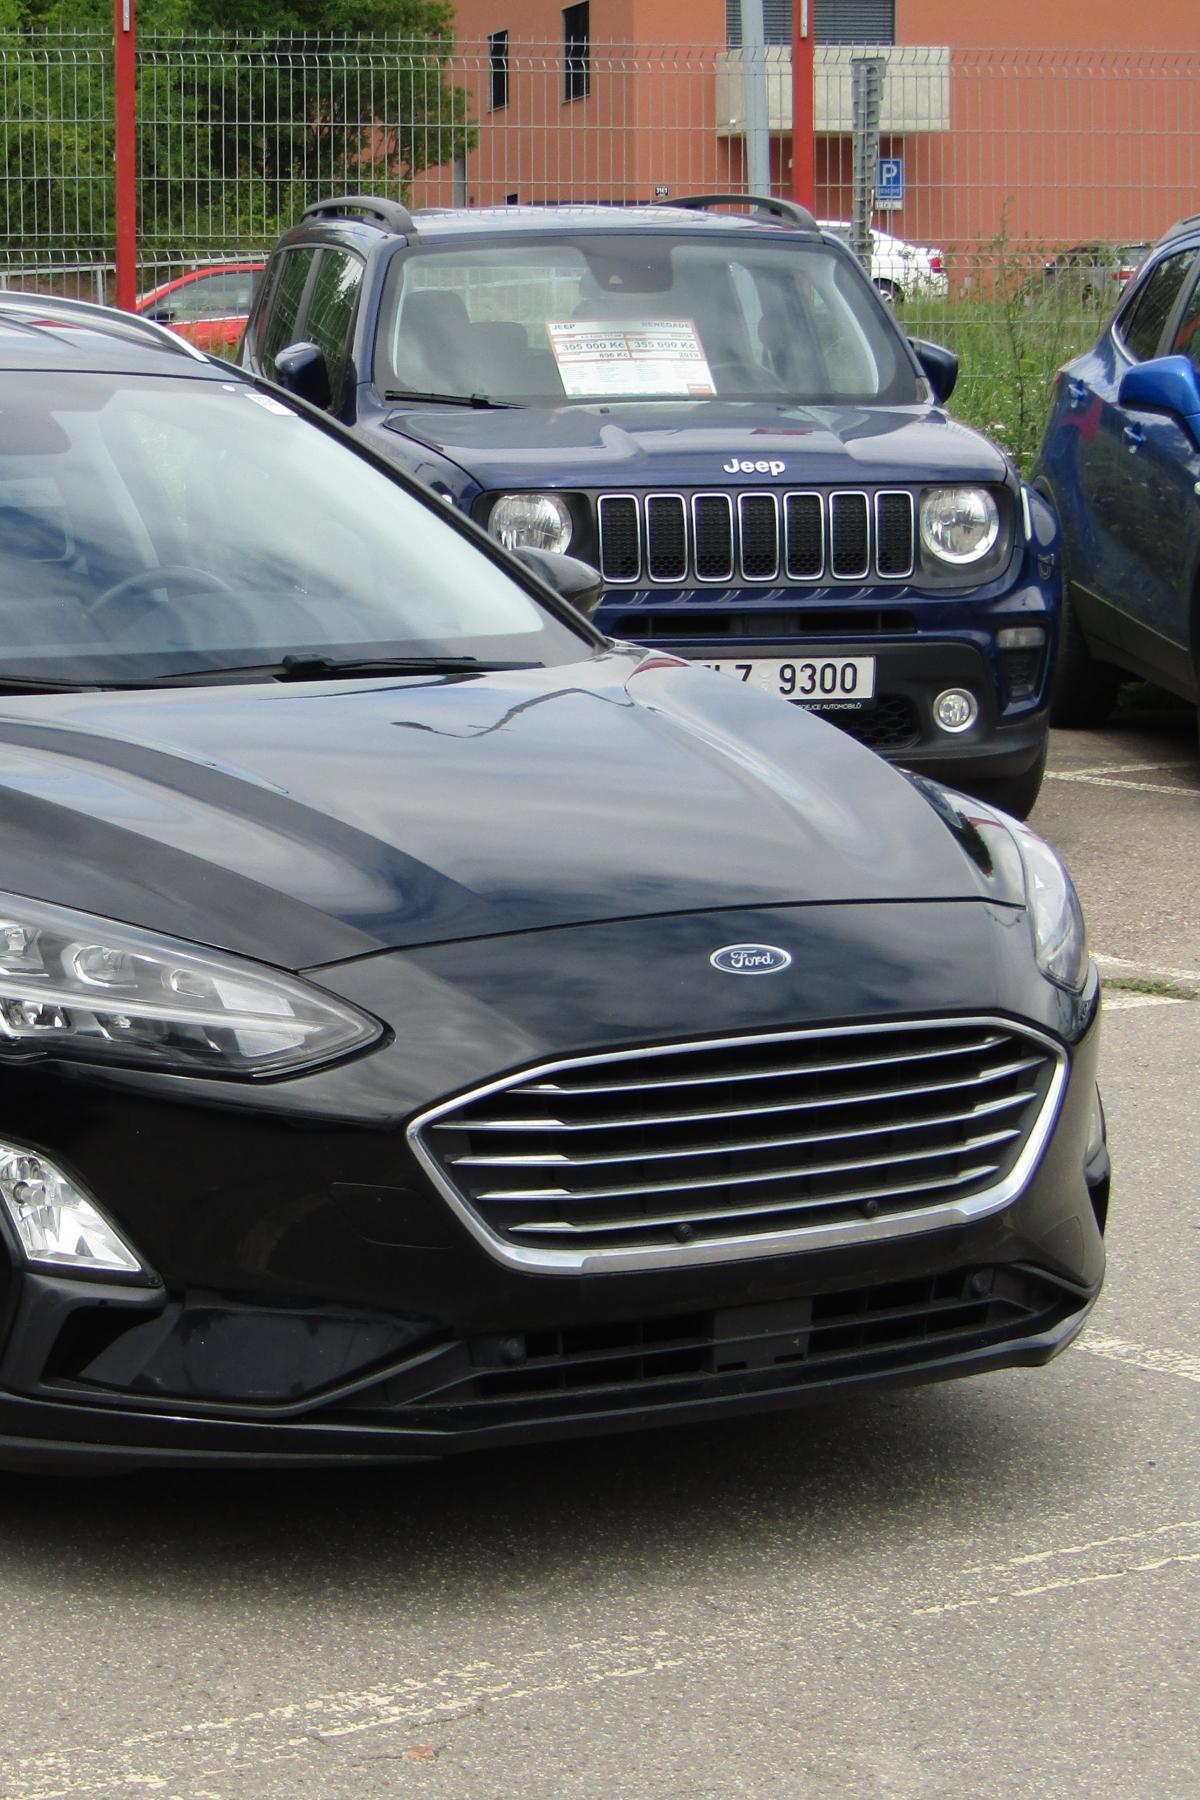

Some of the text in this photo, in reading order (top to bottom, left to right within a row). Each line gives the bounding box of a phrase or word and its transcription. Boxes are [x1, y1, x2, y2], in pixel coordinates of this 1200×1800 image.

[882, 164, 898, 186] P
[586, 342, 607, 350] 000
[722, 458, 786, 476] Jeep
[779, 662, 858, 695] 9300
[822, 702, 862, 710] AUTOMOBILŮ
[730, 950, 775, 968] Ford
